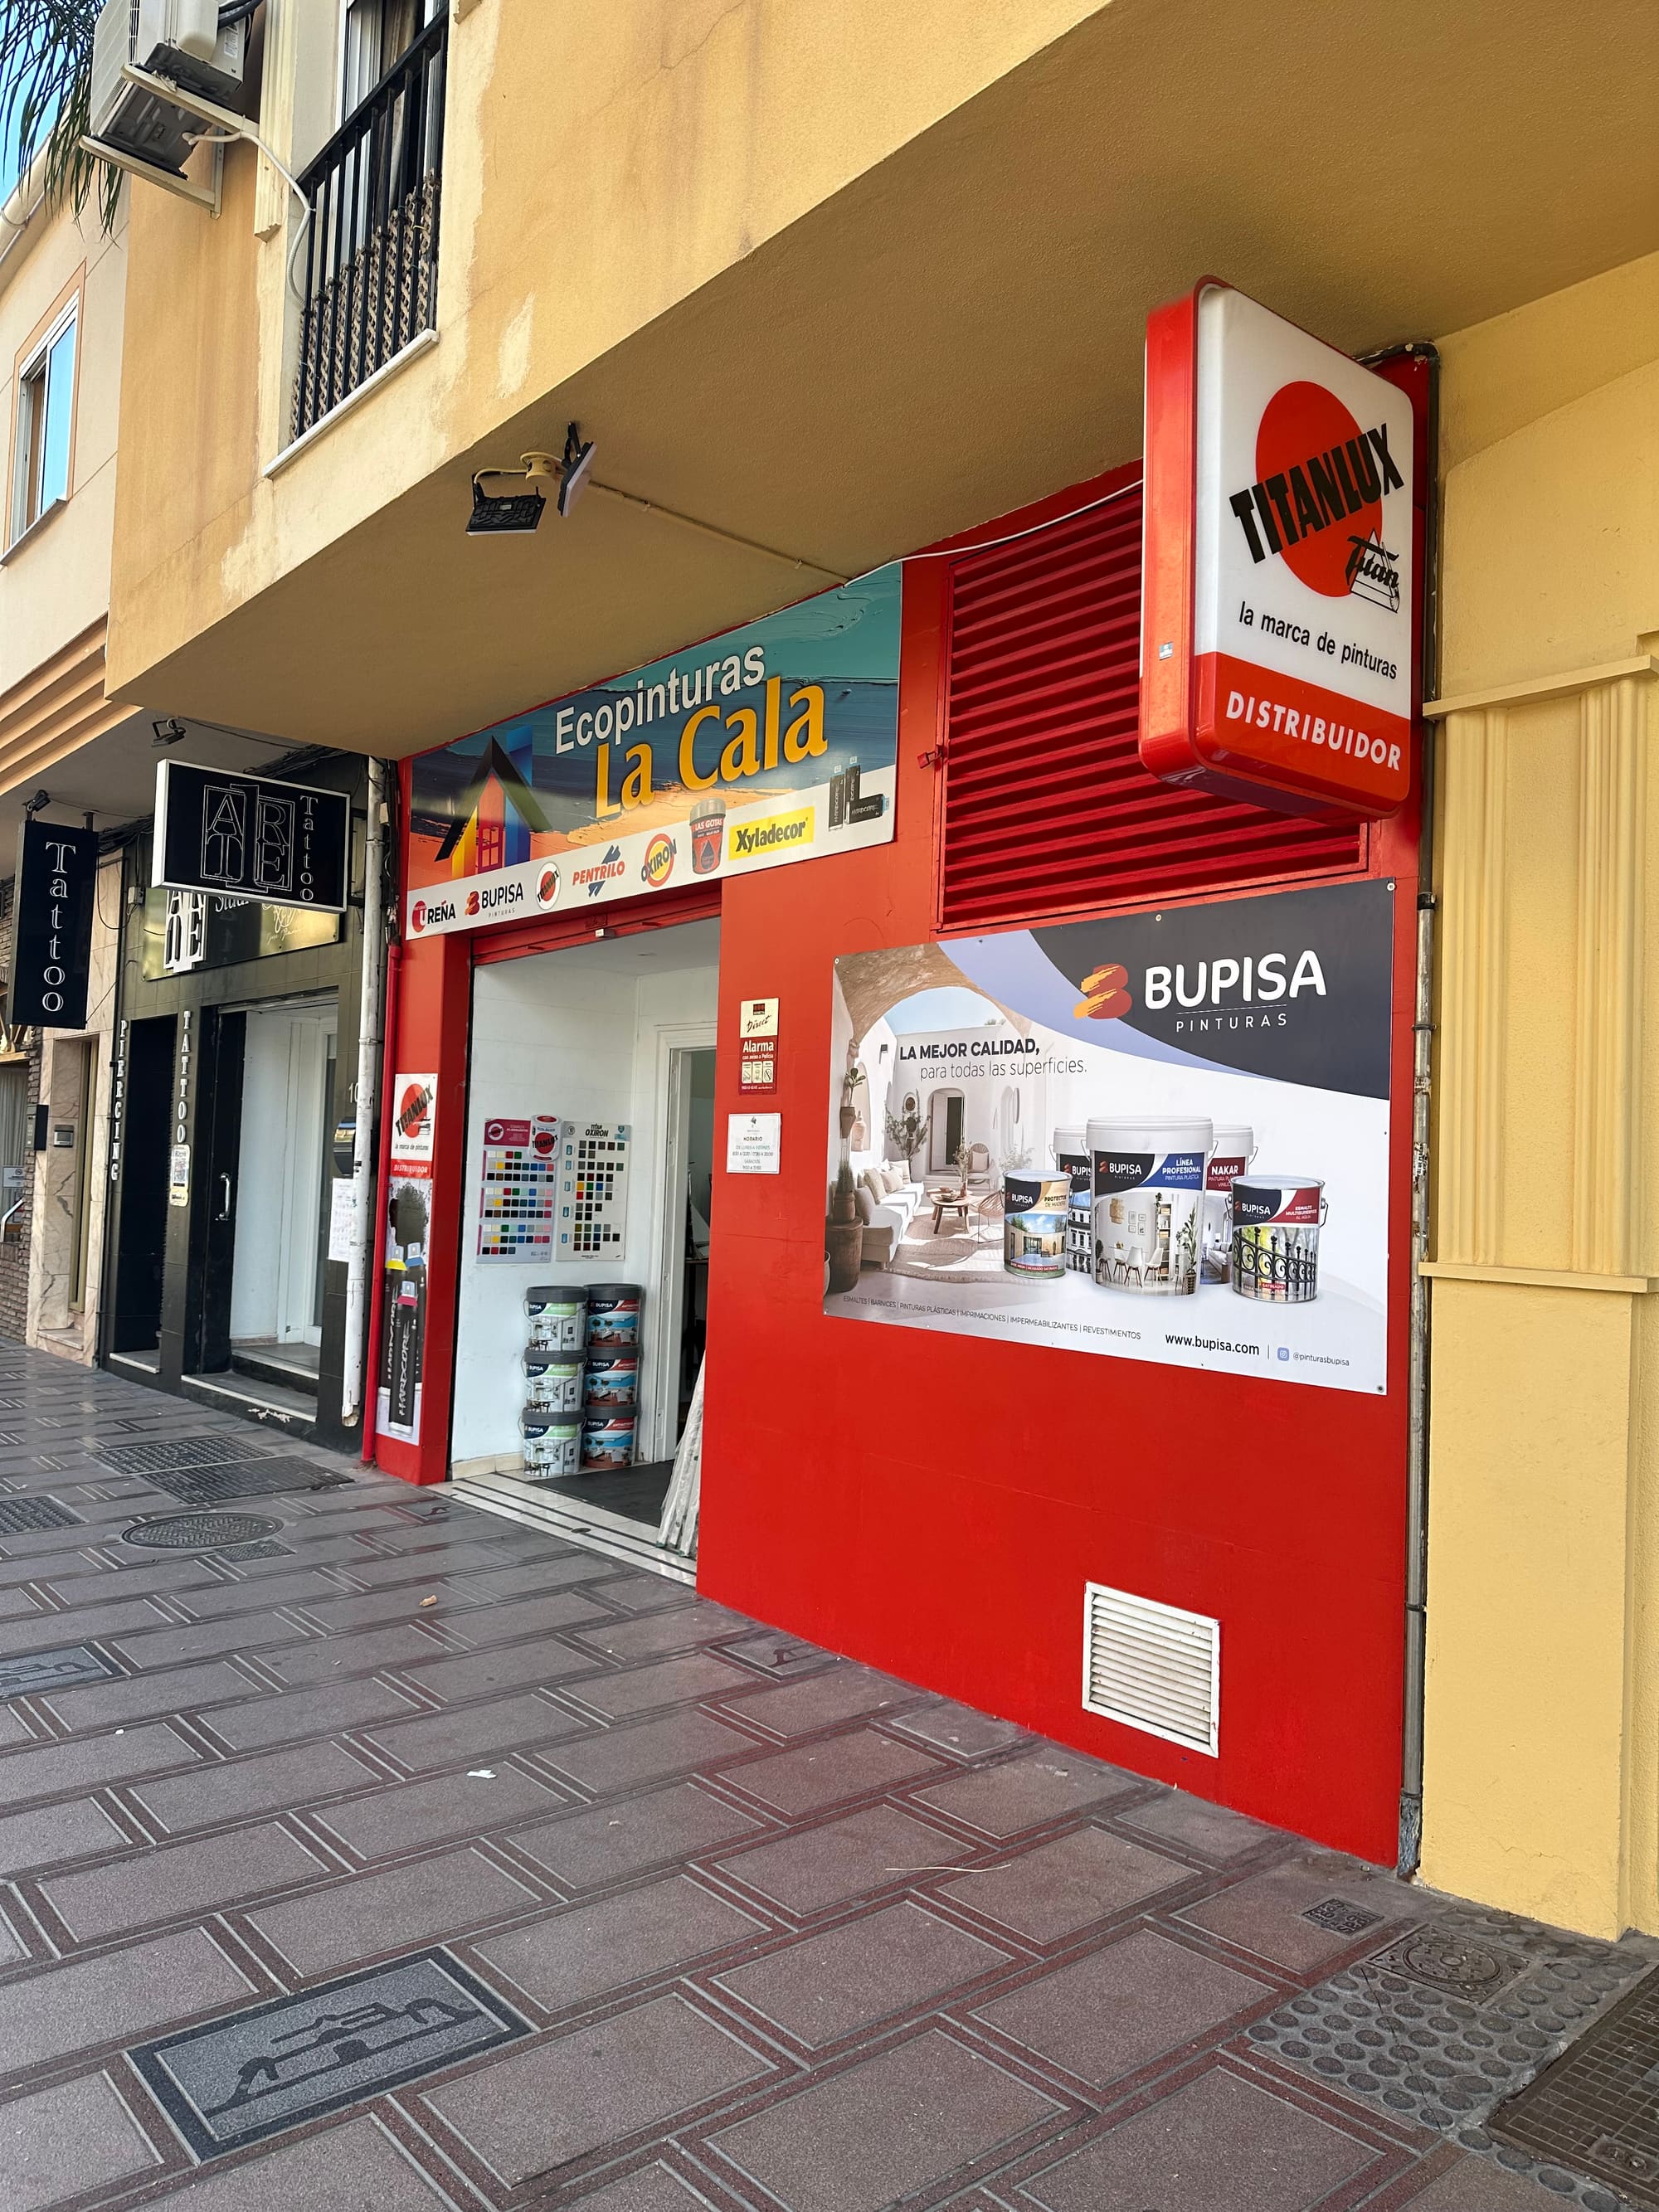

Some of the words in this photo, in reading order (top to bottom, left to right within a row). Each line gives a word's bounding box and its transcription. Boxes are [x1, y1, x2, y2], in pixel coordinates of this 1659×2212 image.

[1228, 424, 1404, 565] TITANLUX
[1345, 535, 1399, 588] Titan
[1239, 601, 1254, 626] la
[1261, 614, 1311, 646] marca
[1316, 632, 1335, 655] de
[1341, 643, 1397, 680] pinturas
[557, 646, 764, 755] Ecopinturas
[1226, 690, 1401, 771] DISTRIBUIDOR
[596, 742, 654, 818] La
[679, 676, 828, 790] Cala
[695, 820, 704, 830] LAS
[705, 818, 722, 828] GOTAS
[736, 821, 807, 853] Xyladecor
[572, 861, 625, 886] PENTRILO
[641, 839, 677, 882] OXIRON
[481, 882, 523, 909] BUPISA
[41, 842, 76, 1013] Tattoo
[1145, 950, 1327, 1009] BUPISA
[1176, 1014, 1287, 1033] PINTURAS
[742, 1040, 774, 1053] Alarma
[900, 1046, 917, 1060] LA
[920, 1043, 967, 1059] MEJOR
[971, 1038, 1040, 1057] CALIDAD,
[177, 1010, 192, 1143] TATTOO
[921, 1064, 946, 1081] para
[951, 1062, 985, 1077] todas
[989, 1061, 1006, 1076] las
[1010, 1057, 1087, 1079] superficies.
[111, 1019, 128, 1181] PIERCING
[585, 1129, 608, 1137] OXIRON
[1109, 1163, 1141, 1174] BUPISA
[1162, 1166, 1201, 1174] PROFESIONAL
[1176, 1157, 1194, 1166] LÍNEA
[1211, 1165, 1238, 1175] NAKAR
[1011, 1194, 1034, 1204] BUPISA
[1242, 1203, 1271, 1215] BUPISA
[843, 1295, 867, 1305] ESMALTES
[870, 1298, 897, 1309] BARNICES
[899, 1301, 926, 1313] PINTURAS
[927, 1305, 956, 1316] PLÁSTICAS
[960, 1310, 1006, 1323] IMPRIMACIONES
[1010, 1315, 1078, 1332] IMPERMEABILIZANTES
[1082, 1325, 1141, 1340] REVESTIMIENTOS
[1165, 1334, 1260, 1355] www.bupisa.com
[399, 1319, 411, 1416] HARDCORE
[1292, 1351, 1350, 1366] @pinturasbupisa
